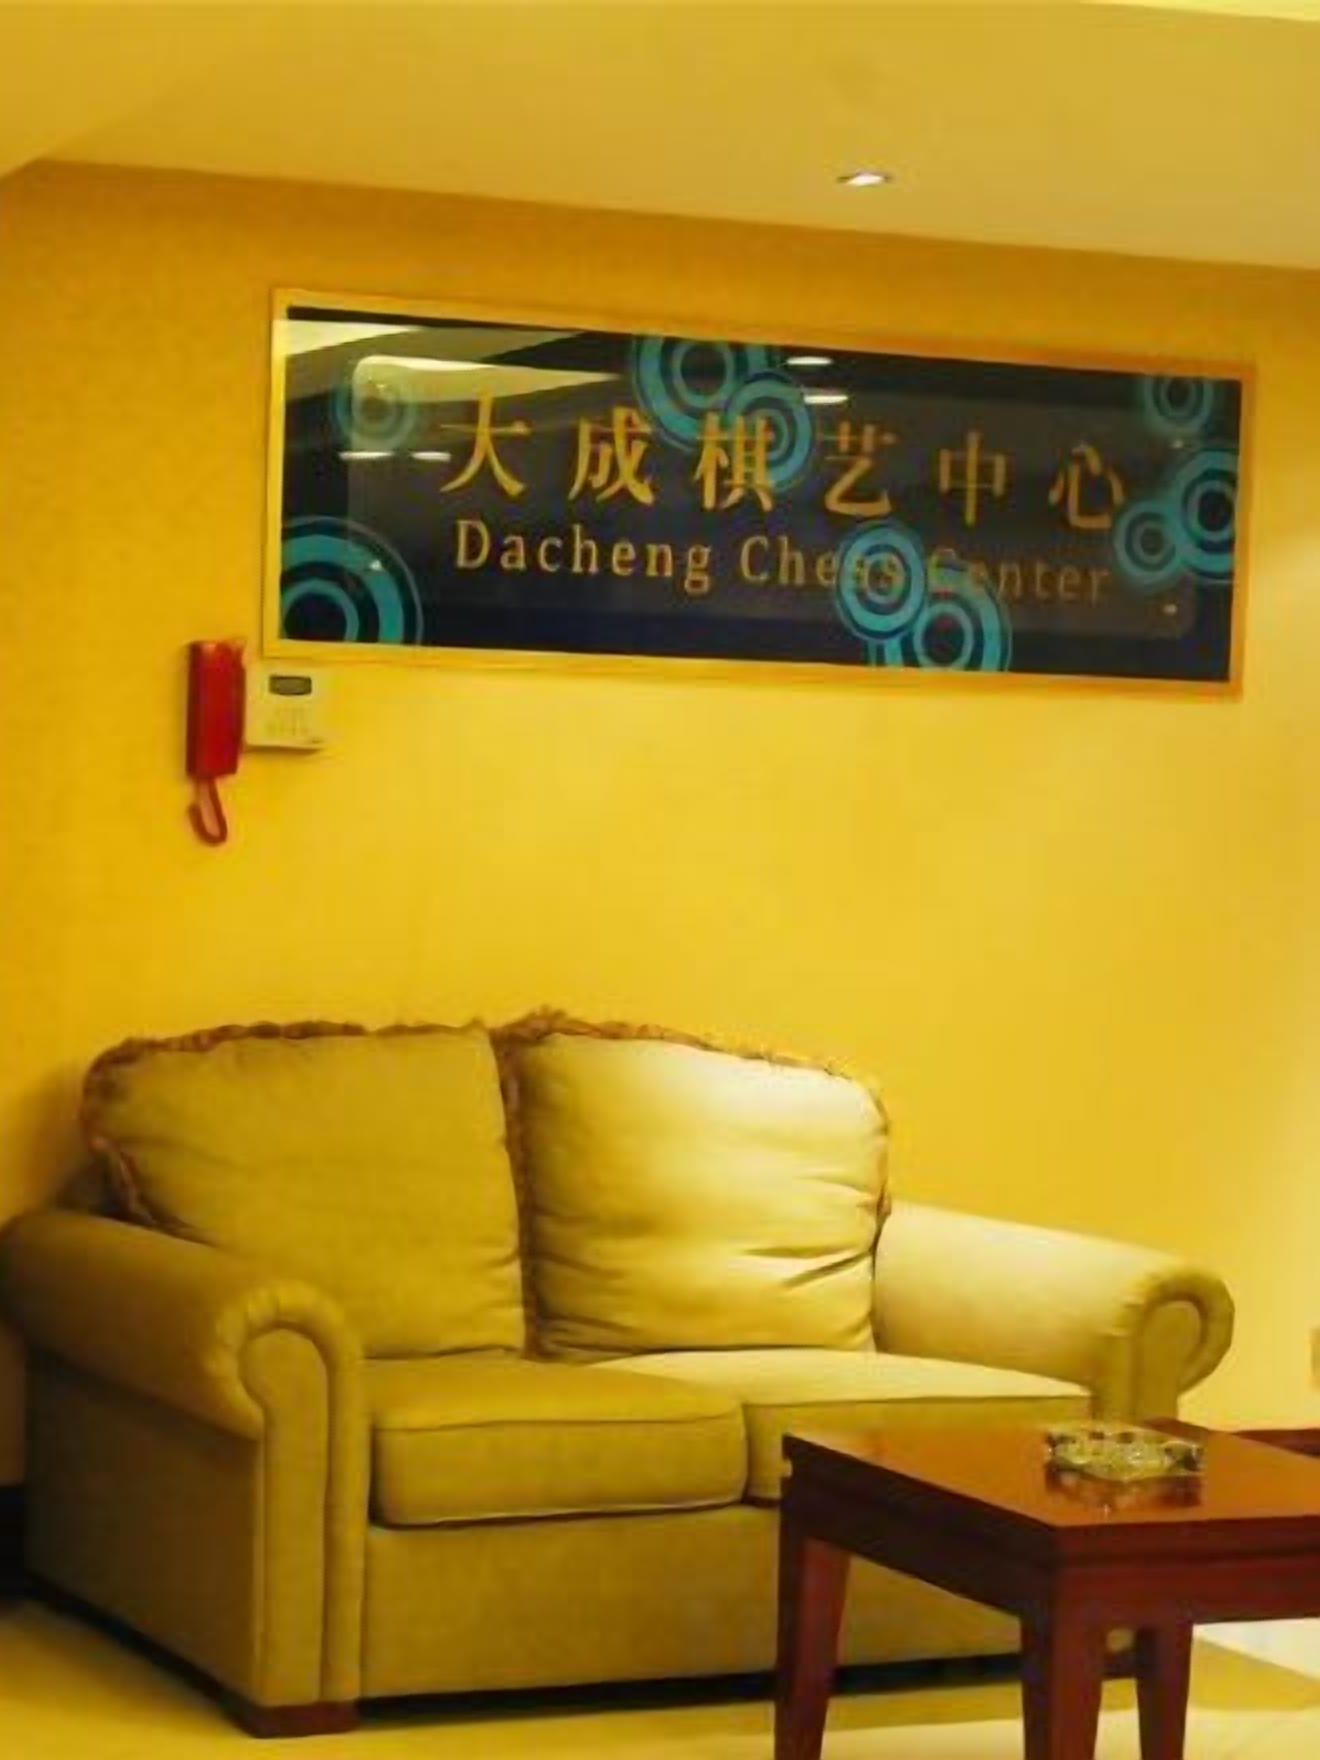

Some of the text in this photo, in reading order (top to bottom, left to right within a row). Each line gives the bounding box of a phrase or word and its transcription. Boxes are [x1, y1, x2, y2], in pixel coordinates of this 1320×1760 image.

[438, 386, 1124, 529] 大成棋艺中心
[455, 519, 1111, 604] Dacheng Chess Center
